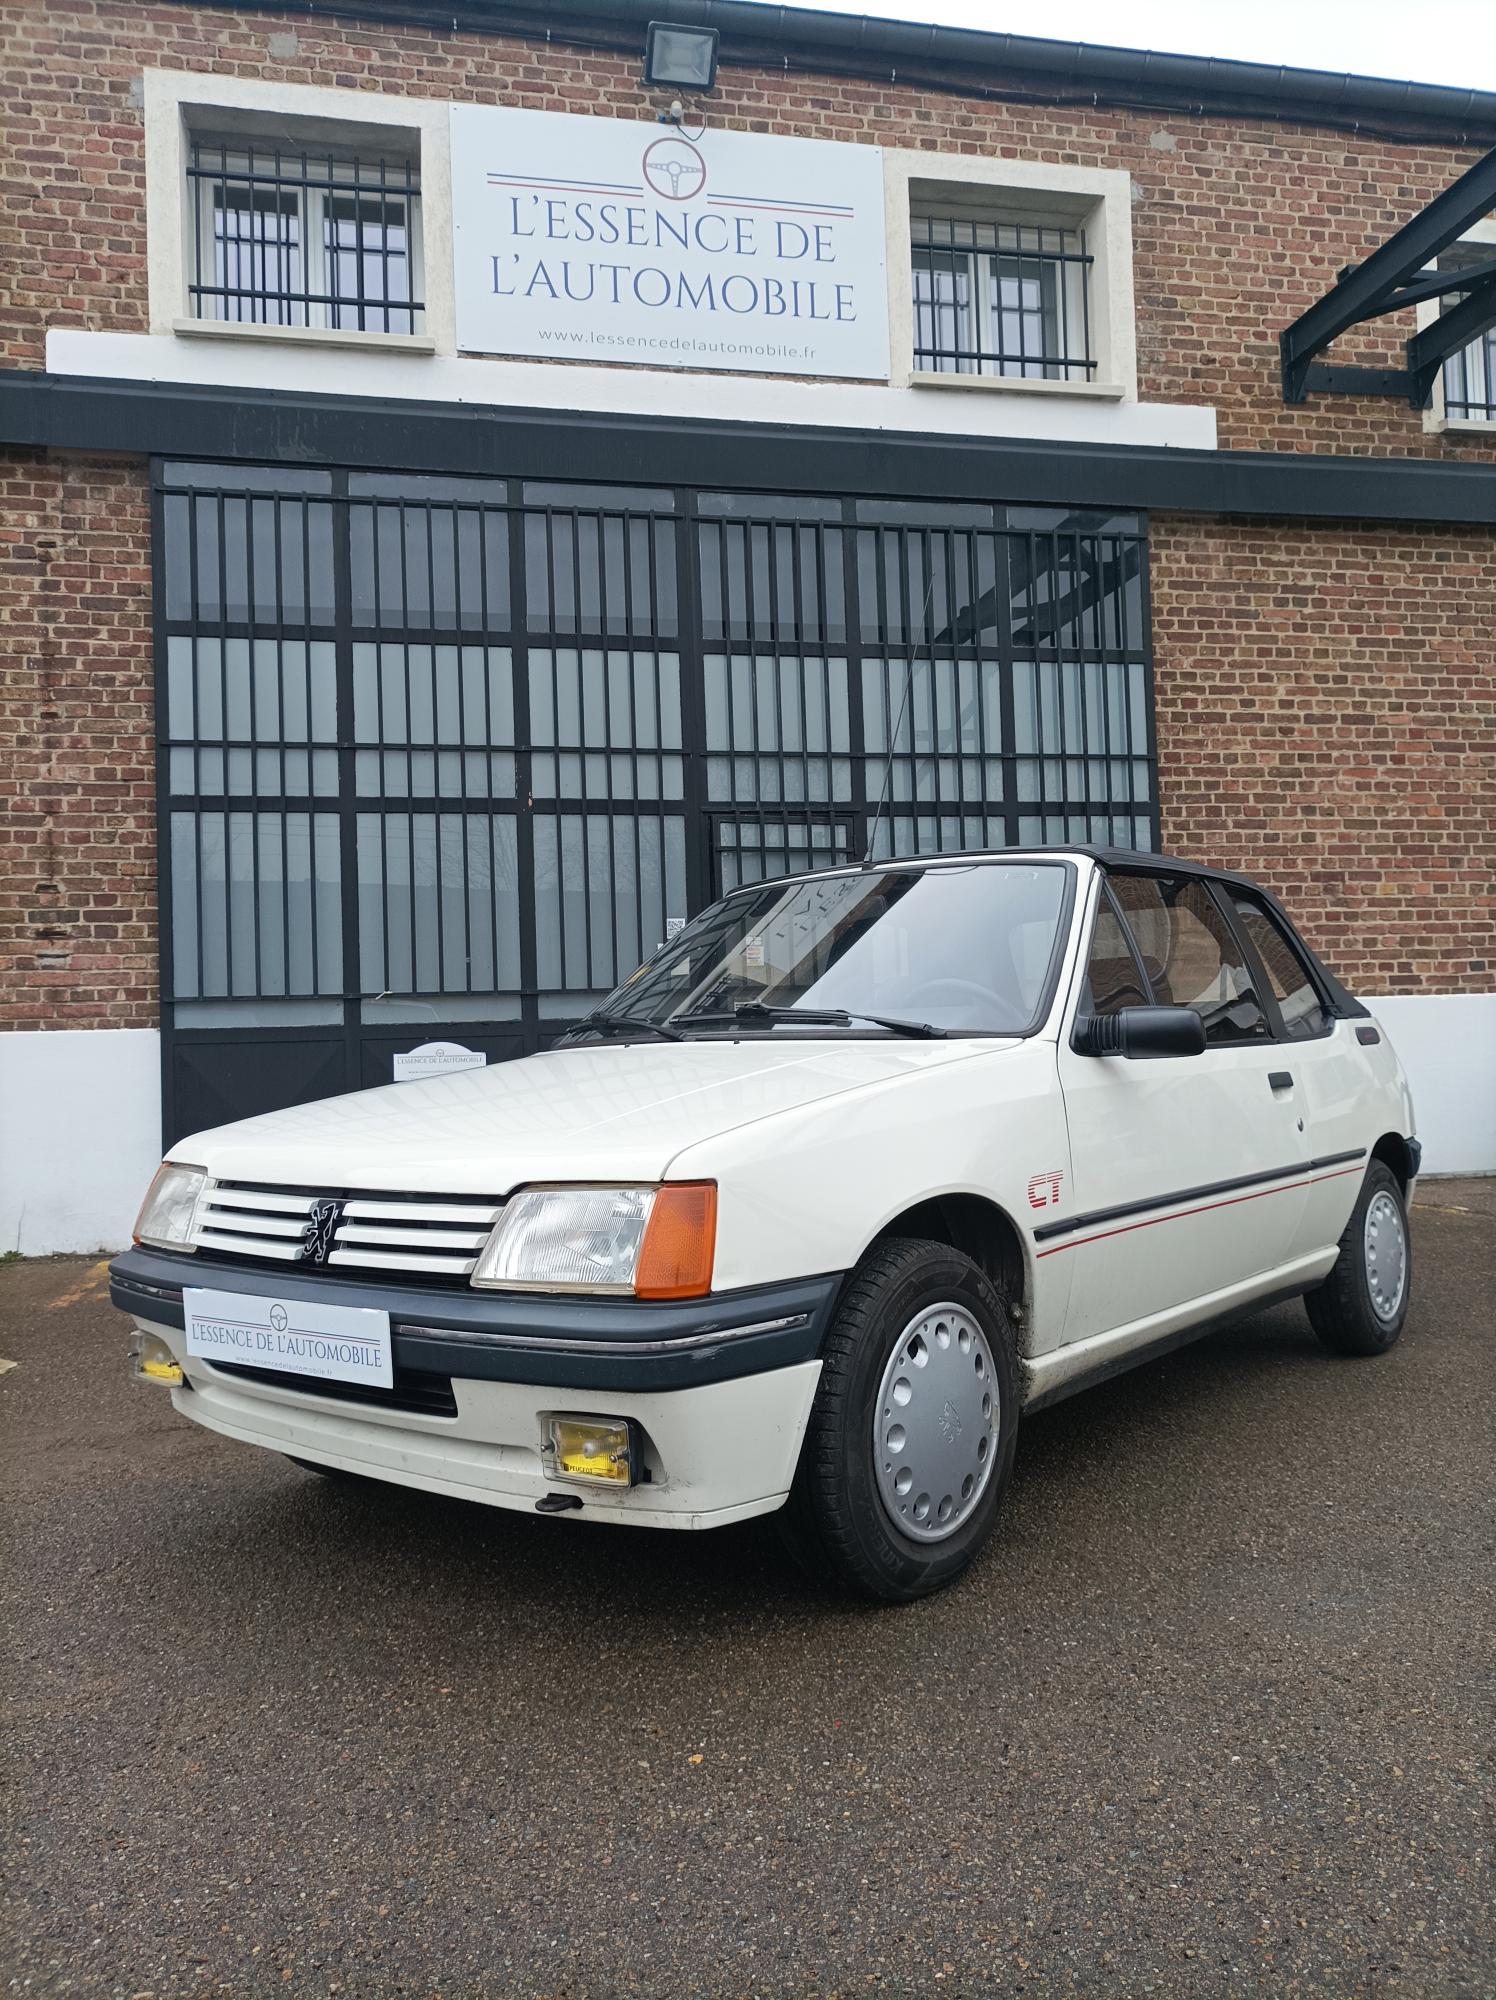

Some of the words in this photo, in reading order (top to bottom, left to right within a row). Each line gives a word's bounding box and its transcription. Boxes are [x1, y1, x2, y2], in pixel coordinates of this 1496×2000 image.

[509, 194, 758, 256] L'ESSENCE
[774, 220, 837, 263] DE
[489, 253, 858, 322] L'AUTOMOBILE
[538, 329, 817, 360] www.lessencedelautomobile.fr
[192, 1323, 253, 1349] L'ESSENCE
[255, 1332, 275, 1352] DE
[277, 1335, 382, 1368] L'AUTOMOBILE
[569, 1465, 593, 1475] PEUGEOT
